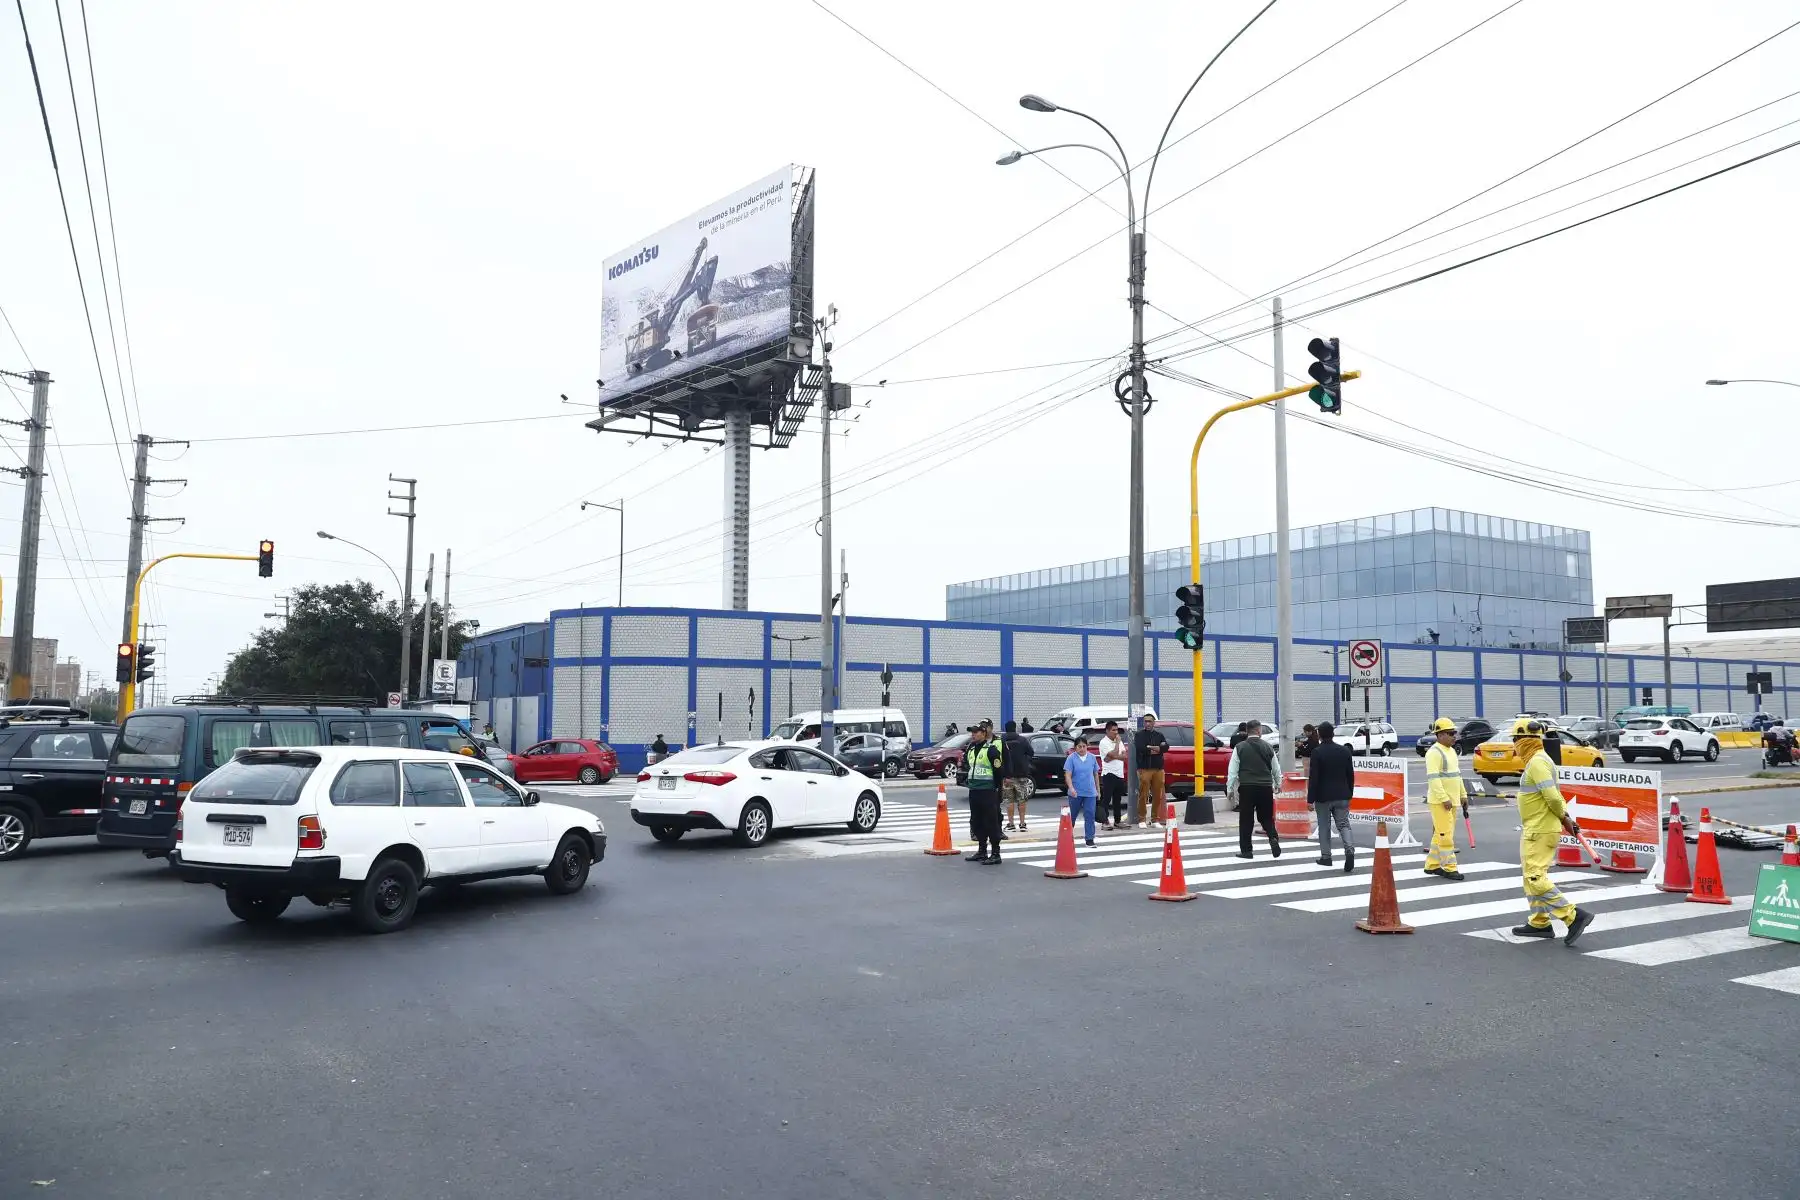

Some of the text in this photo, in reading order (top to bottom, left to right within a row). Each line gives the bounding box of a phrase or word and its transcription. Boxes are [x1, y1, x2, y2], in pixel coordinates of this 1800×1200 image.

[698, 179, 784, 230] Elevamos la productividad
[710, 224, 719, 236] de
[750, 206, 759, 216] en
[608, 244, 659, 281] KOMATSU
[441, 666, 450, 678] E
[1360, 669, 1371, 677] NO
[1352, 677, 1380, 685] CAMIONES
[1353, 760, 1401, 770] LAUSURADA
[1573, 771, 1652, 785] CLAUSURADA
[1570, 837, 1592, 846] SOO
[1593, 840, 1655, 853] PROPIETARIOS
